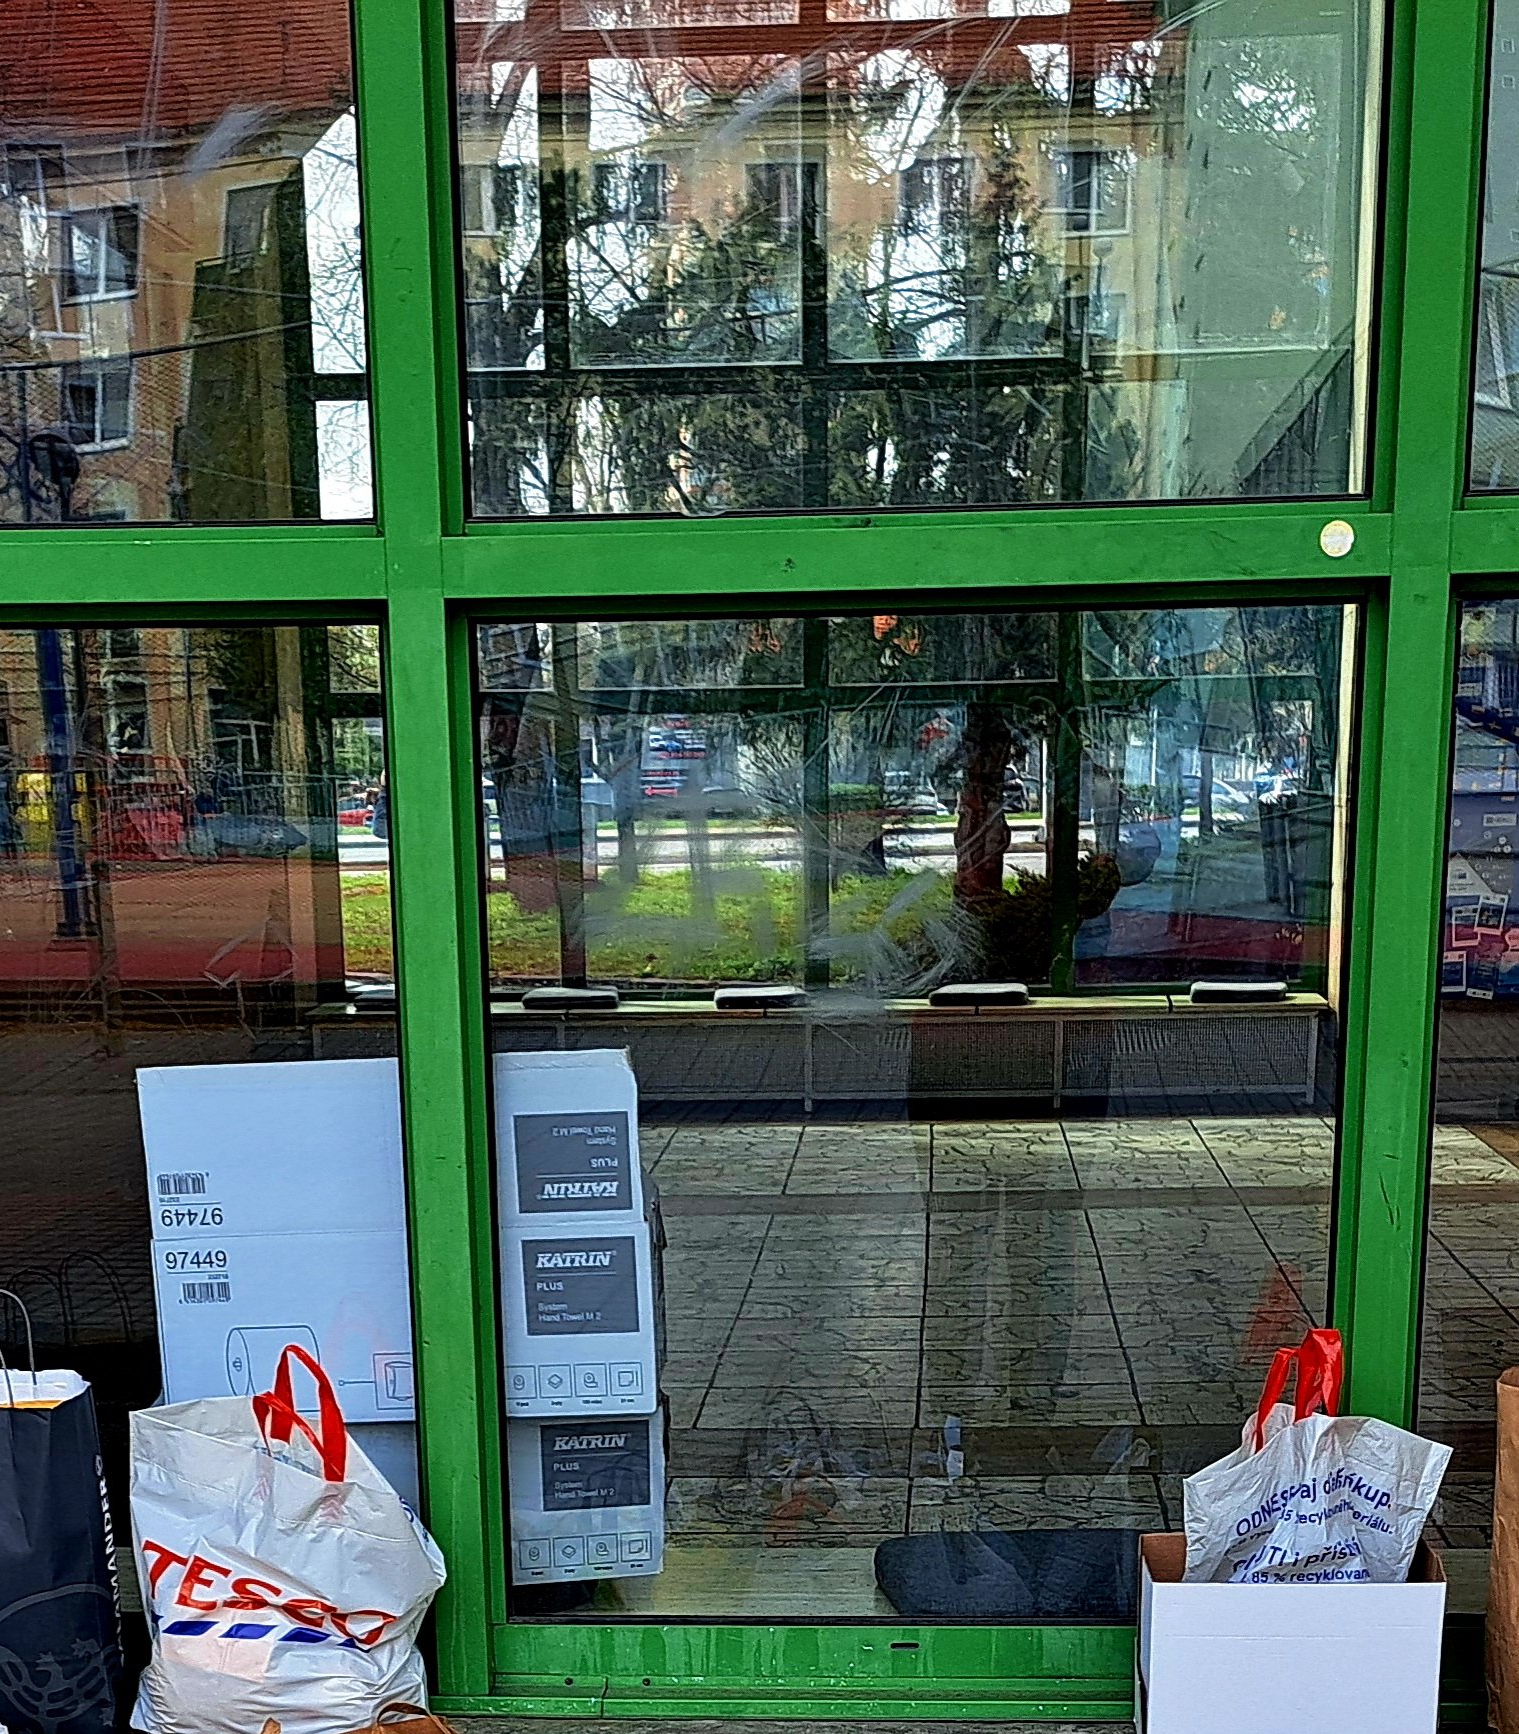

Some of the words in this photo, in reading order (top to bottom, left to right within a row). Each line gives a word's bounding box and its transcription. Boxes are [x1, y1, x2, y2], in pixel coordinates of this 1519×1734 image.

[591, 1158, 618, 1168] PLUS
[161, 1207, 223, 1227] 97449
[165, 1250, 227, 1269] 97449
[536, 1282, 563, 1291] PLUS
[553, 1462, 580, 1471] PLUS
[1252, 1572, 1269, 1584] 85
[1273, 1573, 1285, 1582] %
[142, 1539, 398, 1646] TESCO
